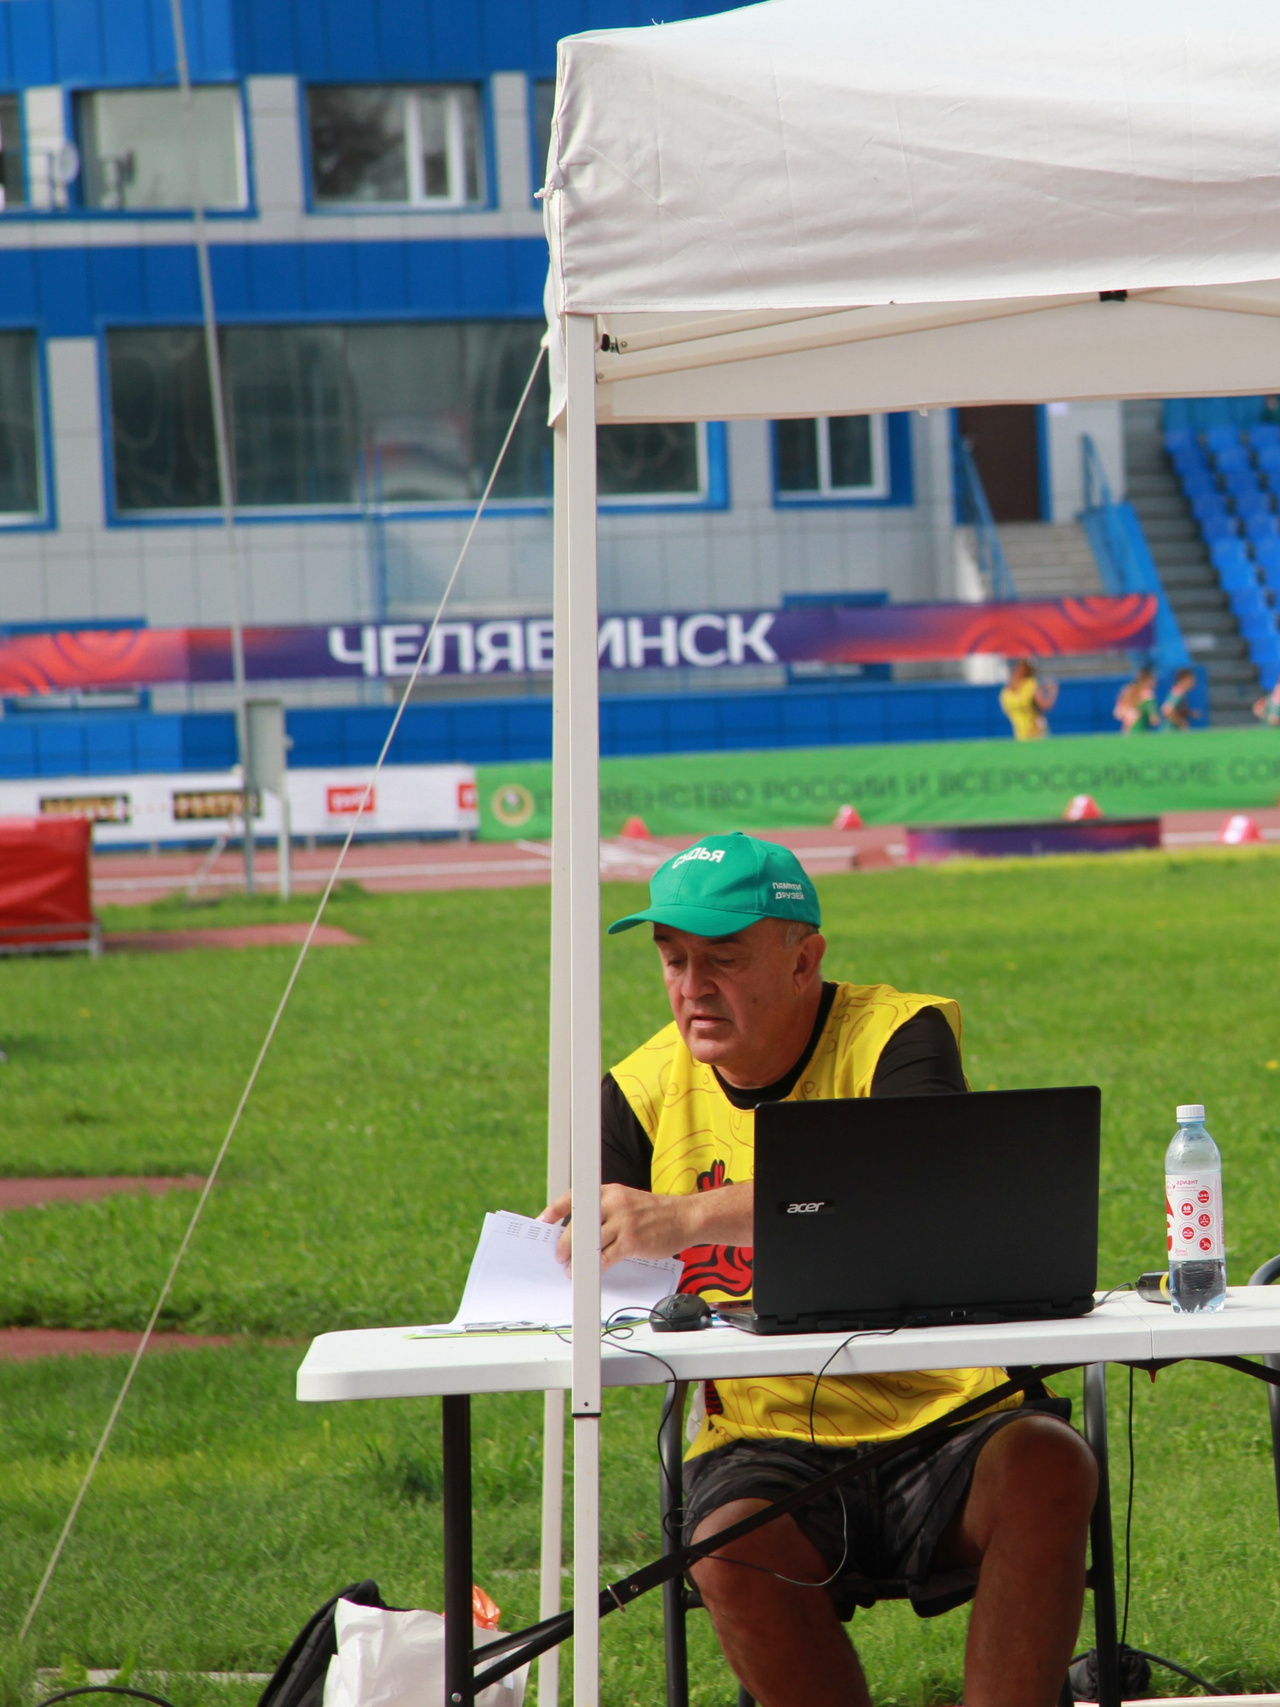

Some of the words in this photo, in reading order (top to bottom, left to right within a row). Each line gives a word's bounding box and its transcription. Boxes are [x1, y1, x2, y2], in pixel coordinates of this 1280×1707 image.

[760, 773, 899, 806] РОССИИ
[904, 770, 929, 797] И
[937, 756, 1217, 798] ВСЕРОССИЙСКИЕ
[786, 1202, 825, 1213] acer
